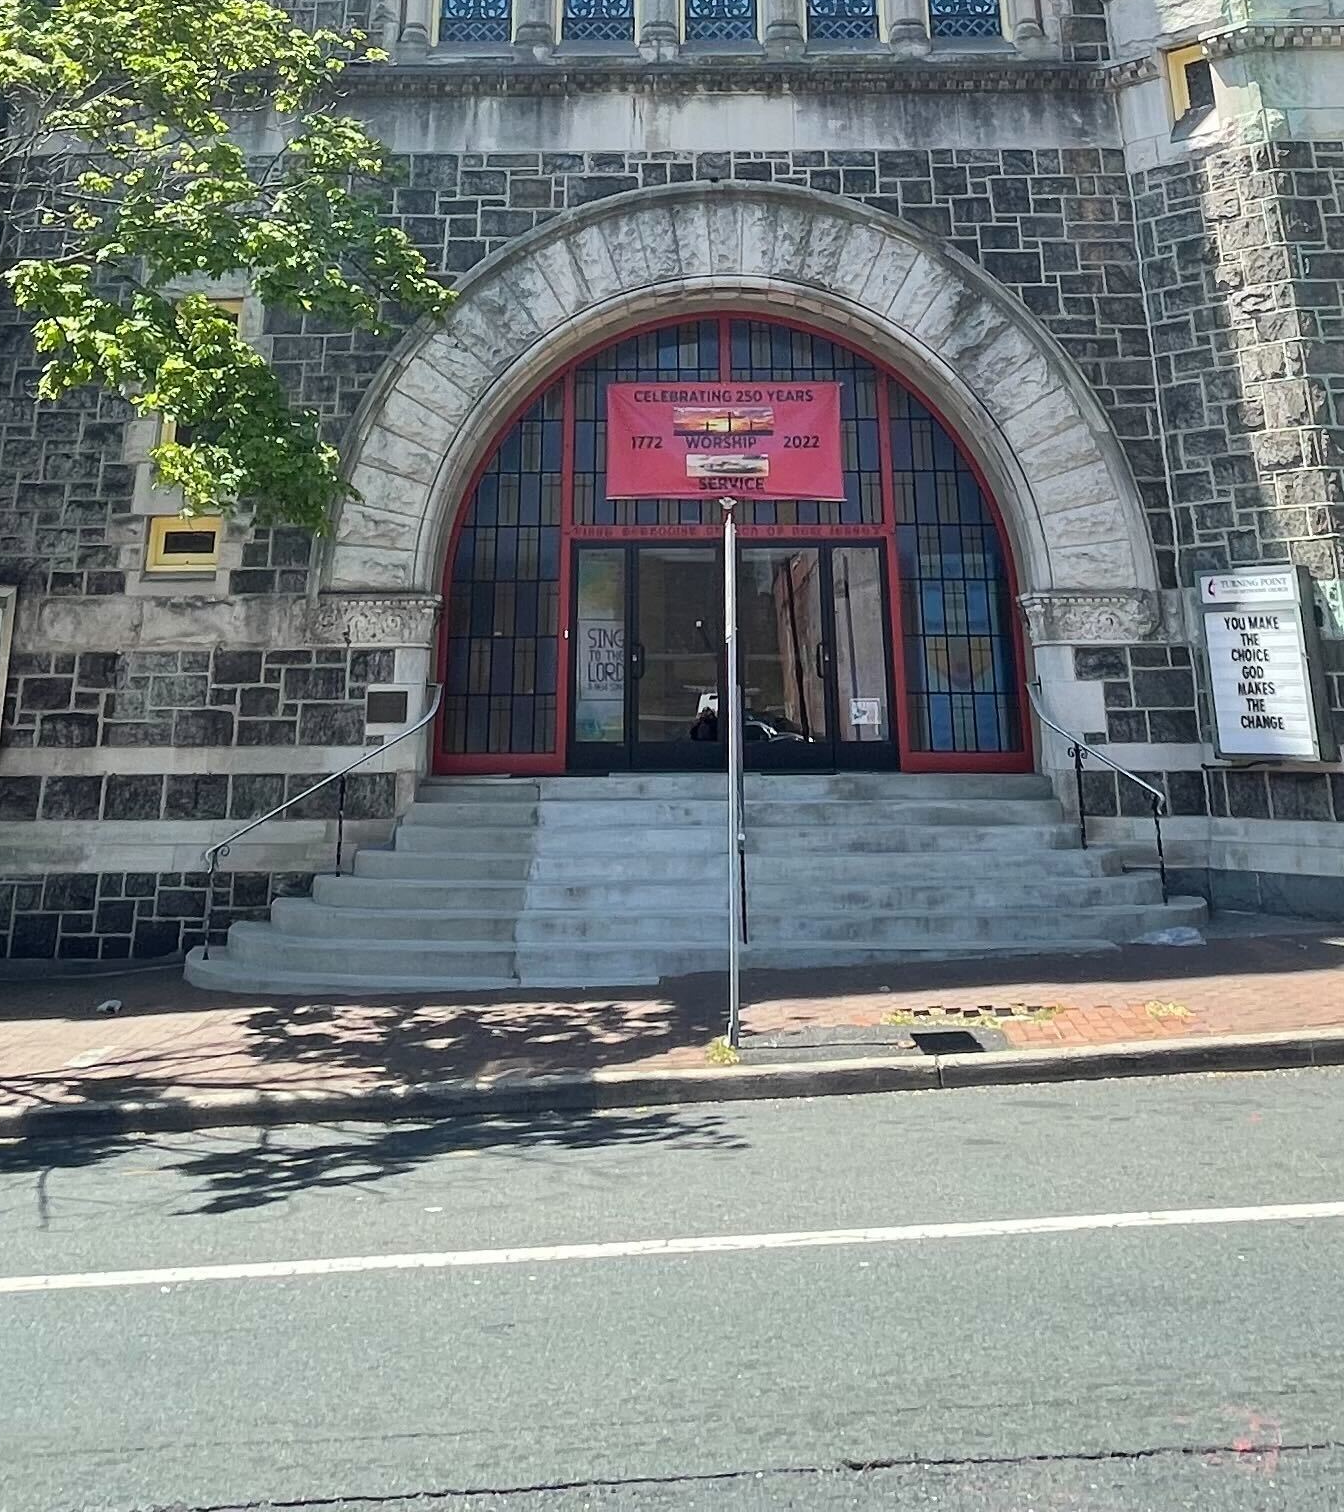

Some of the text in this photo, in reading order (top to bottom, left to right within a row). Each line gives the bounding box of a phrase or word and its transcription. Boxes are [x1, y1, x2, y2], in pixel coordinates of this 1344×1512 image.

[633, 389, 813, 403] CELEBRATING 250 YEARS
[631, 436, 663, 449] 1772
[685, 436, 757, 449] WORSHIP
[784, 436, 820, 448] 2022
[698, 477, 764, 491] SERVICE
[1220, 577, 1287, 588] TURNING POINT
[1224, 616, 1279, 630] YOU MAKE
[1240, 633, 1259, 646] THE
[589, 650, 601, 662] TO
[1231, 648, 1270, 662] CHOICE
[588, 662, 624, 682] LORD
[1242, 665, 1264, 679] GOD
[1238, 681, 1275, 696] MAKES
[1246, 698, 1266, 712] THE
[1241, 715, 1285, 730] CHANGE
